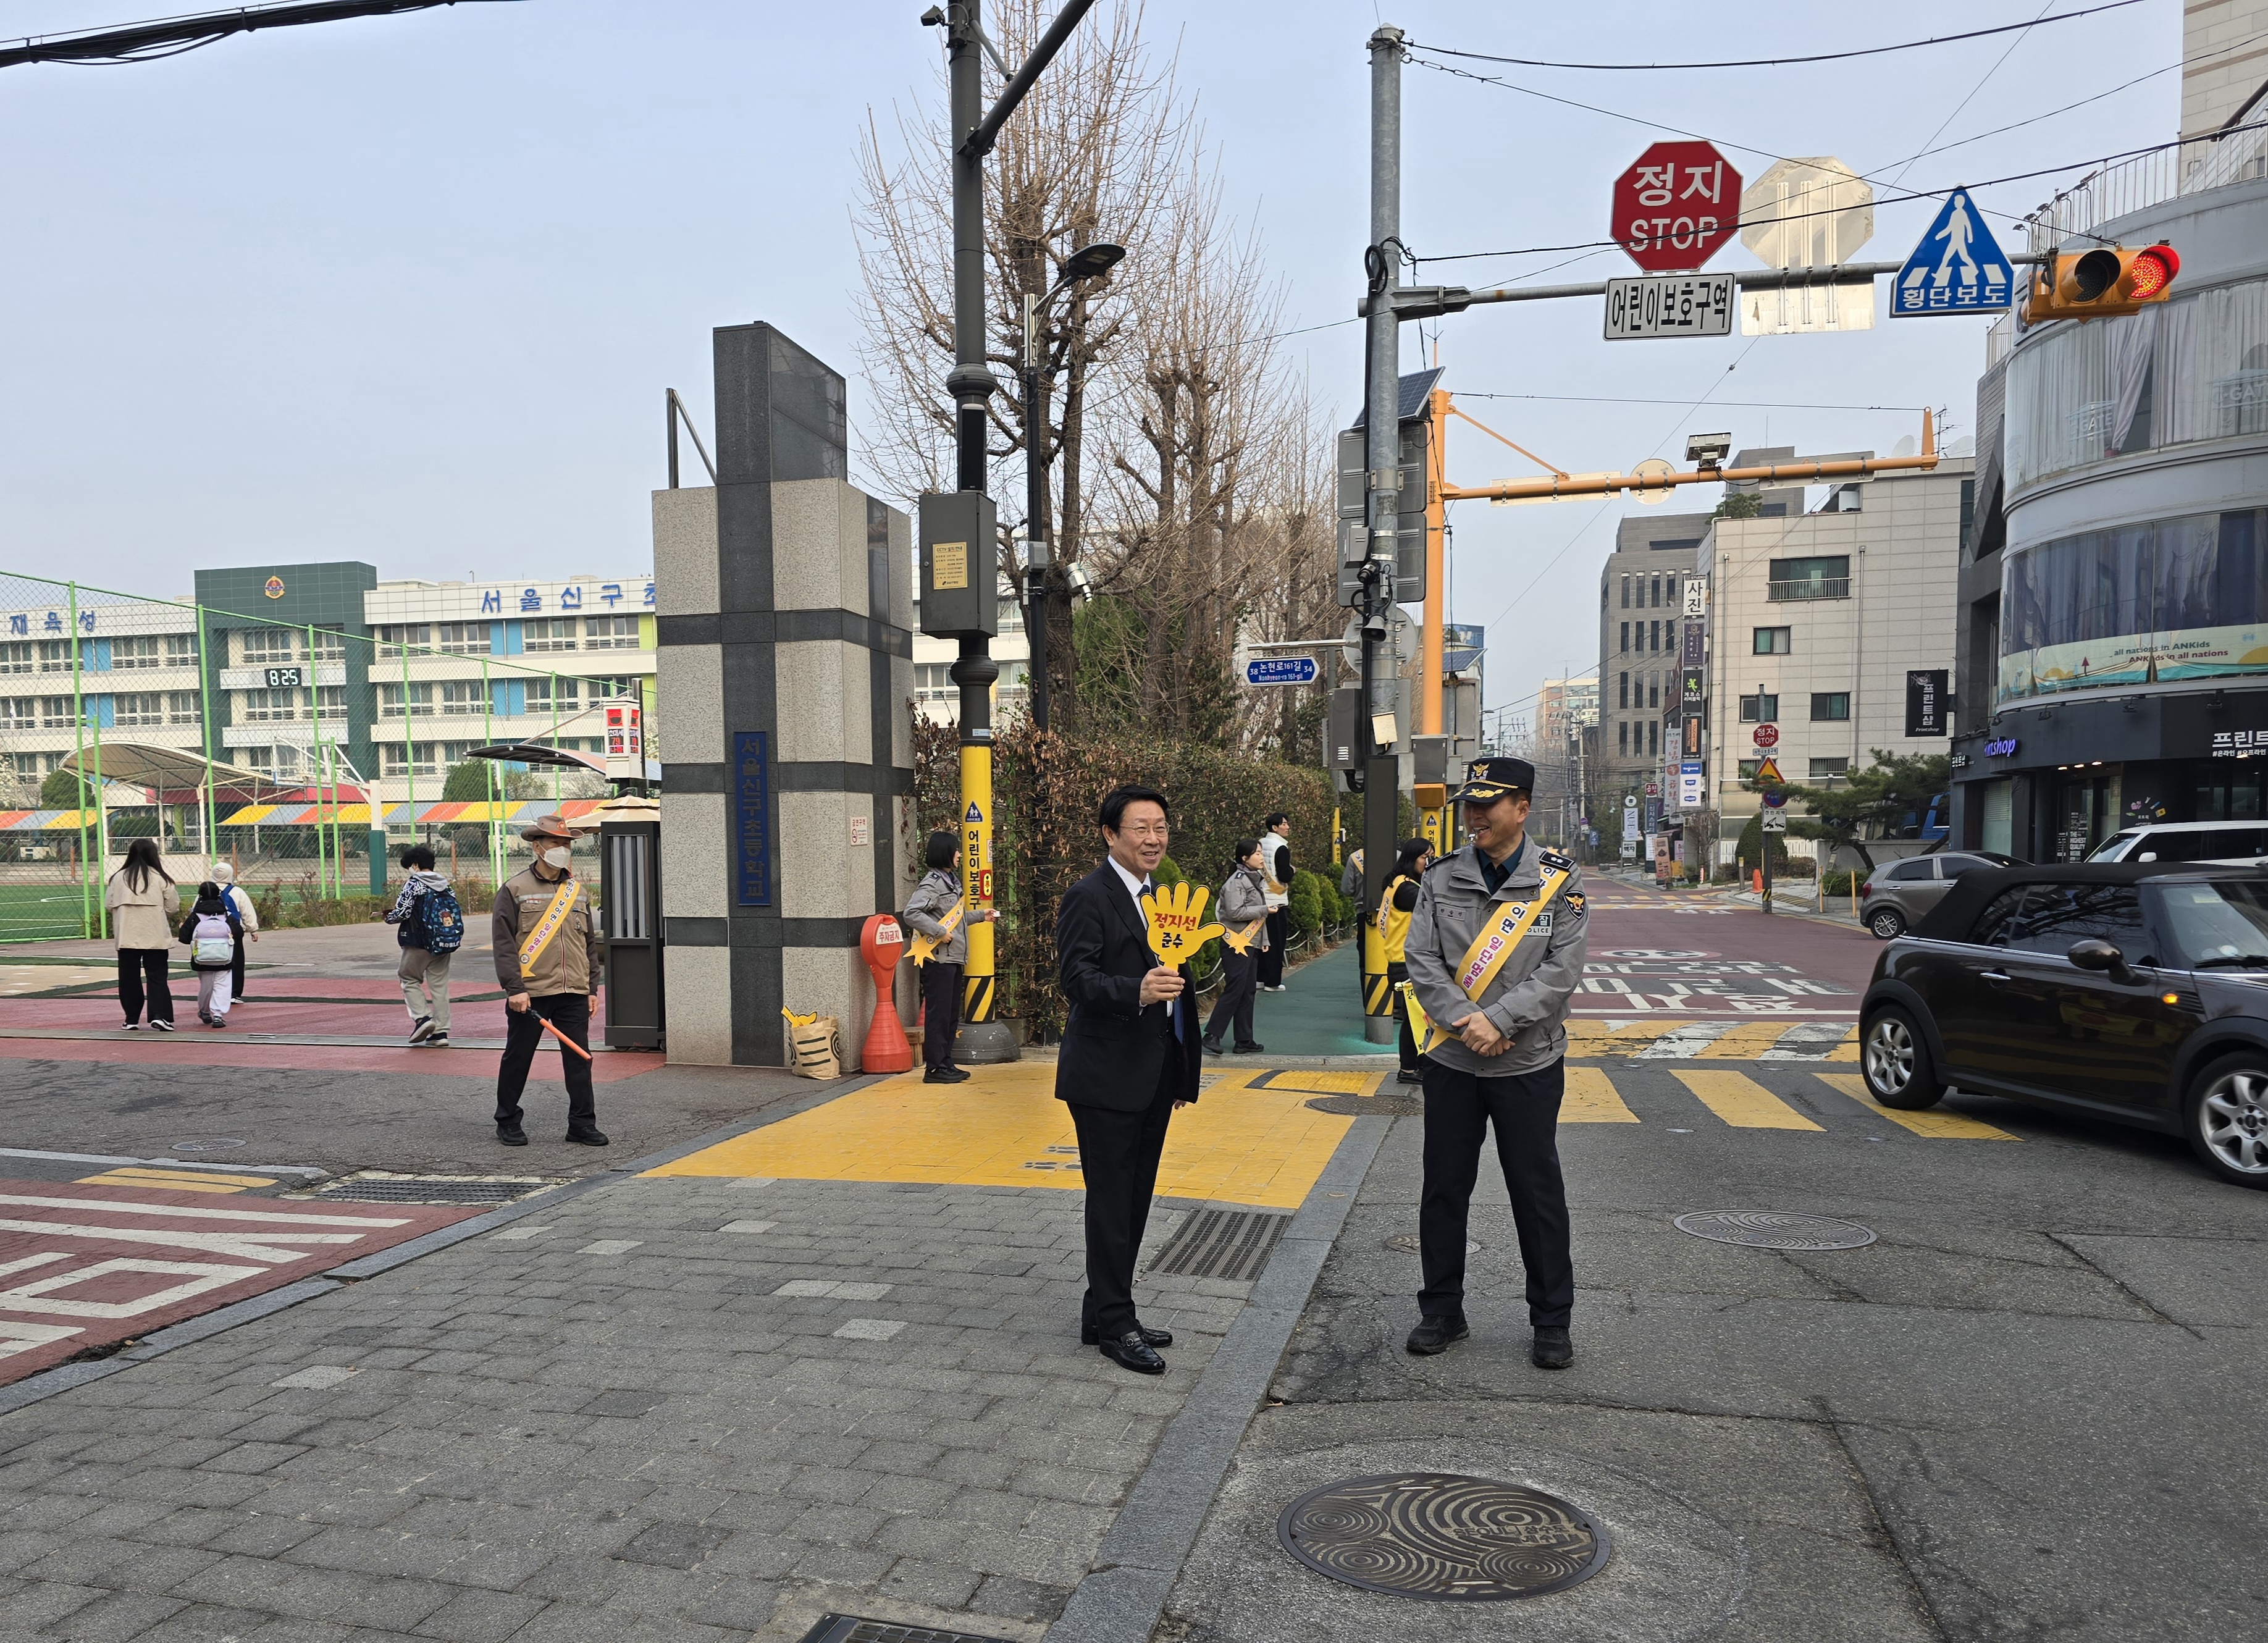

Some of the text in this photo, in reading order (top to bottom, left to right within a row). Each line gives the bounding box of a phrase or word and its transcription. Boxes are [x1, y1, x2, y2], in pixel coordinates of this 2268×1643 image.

[1633, 161, 1723, 206] 정지
[1629, 216, 1718, 251] STOP
[1611, 279, 1728, 333] 어린이보호구역
[1902, 285, 2006, 309] 횡단보도
[1687, 581, 1703, 613] 사진
[2126, 645, 2158, 655] nations
[2172, 641, 2211, 650] ANKids
[2128, 655, 2165, 664] ANKds
[2191, 649, 2228, 658] nations
[1259, 661, 1301, 674] 논현로161길
[1258, 673, 1303, 682] Nonhyeon-ro 161-gil
[1756, 727, 1775, 736] 정지
[2212, 731, 2268, 747] 프린트
[741, 738, 765, 898] 서울신구초등학교
[968, 830, 981, 910] 어린이보호구
[549, 899, 566, 923] 보이면
[1500, 899, 1532, 934] 이면
[1539, 914, 1550, 927] 찰
[1154, 912, 1197, 931] 정지선
[1162, 931, 1183, 949] 준수
[1463, 936, 1505, 990] 일단멈춤
[1624, 994, 1816, 1011] 정지
[1453, 1527, 1511, 1536] SEOUL
